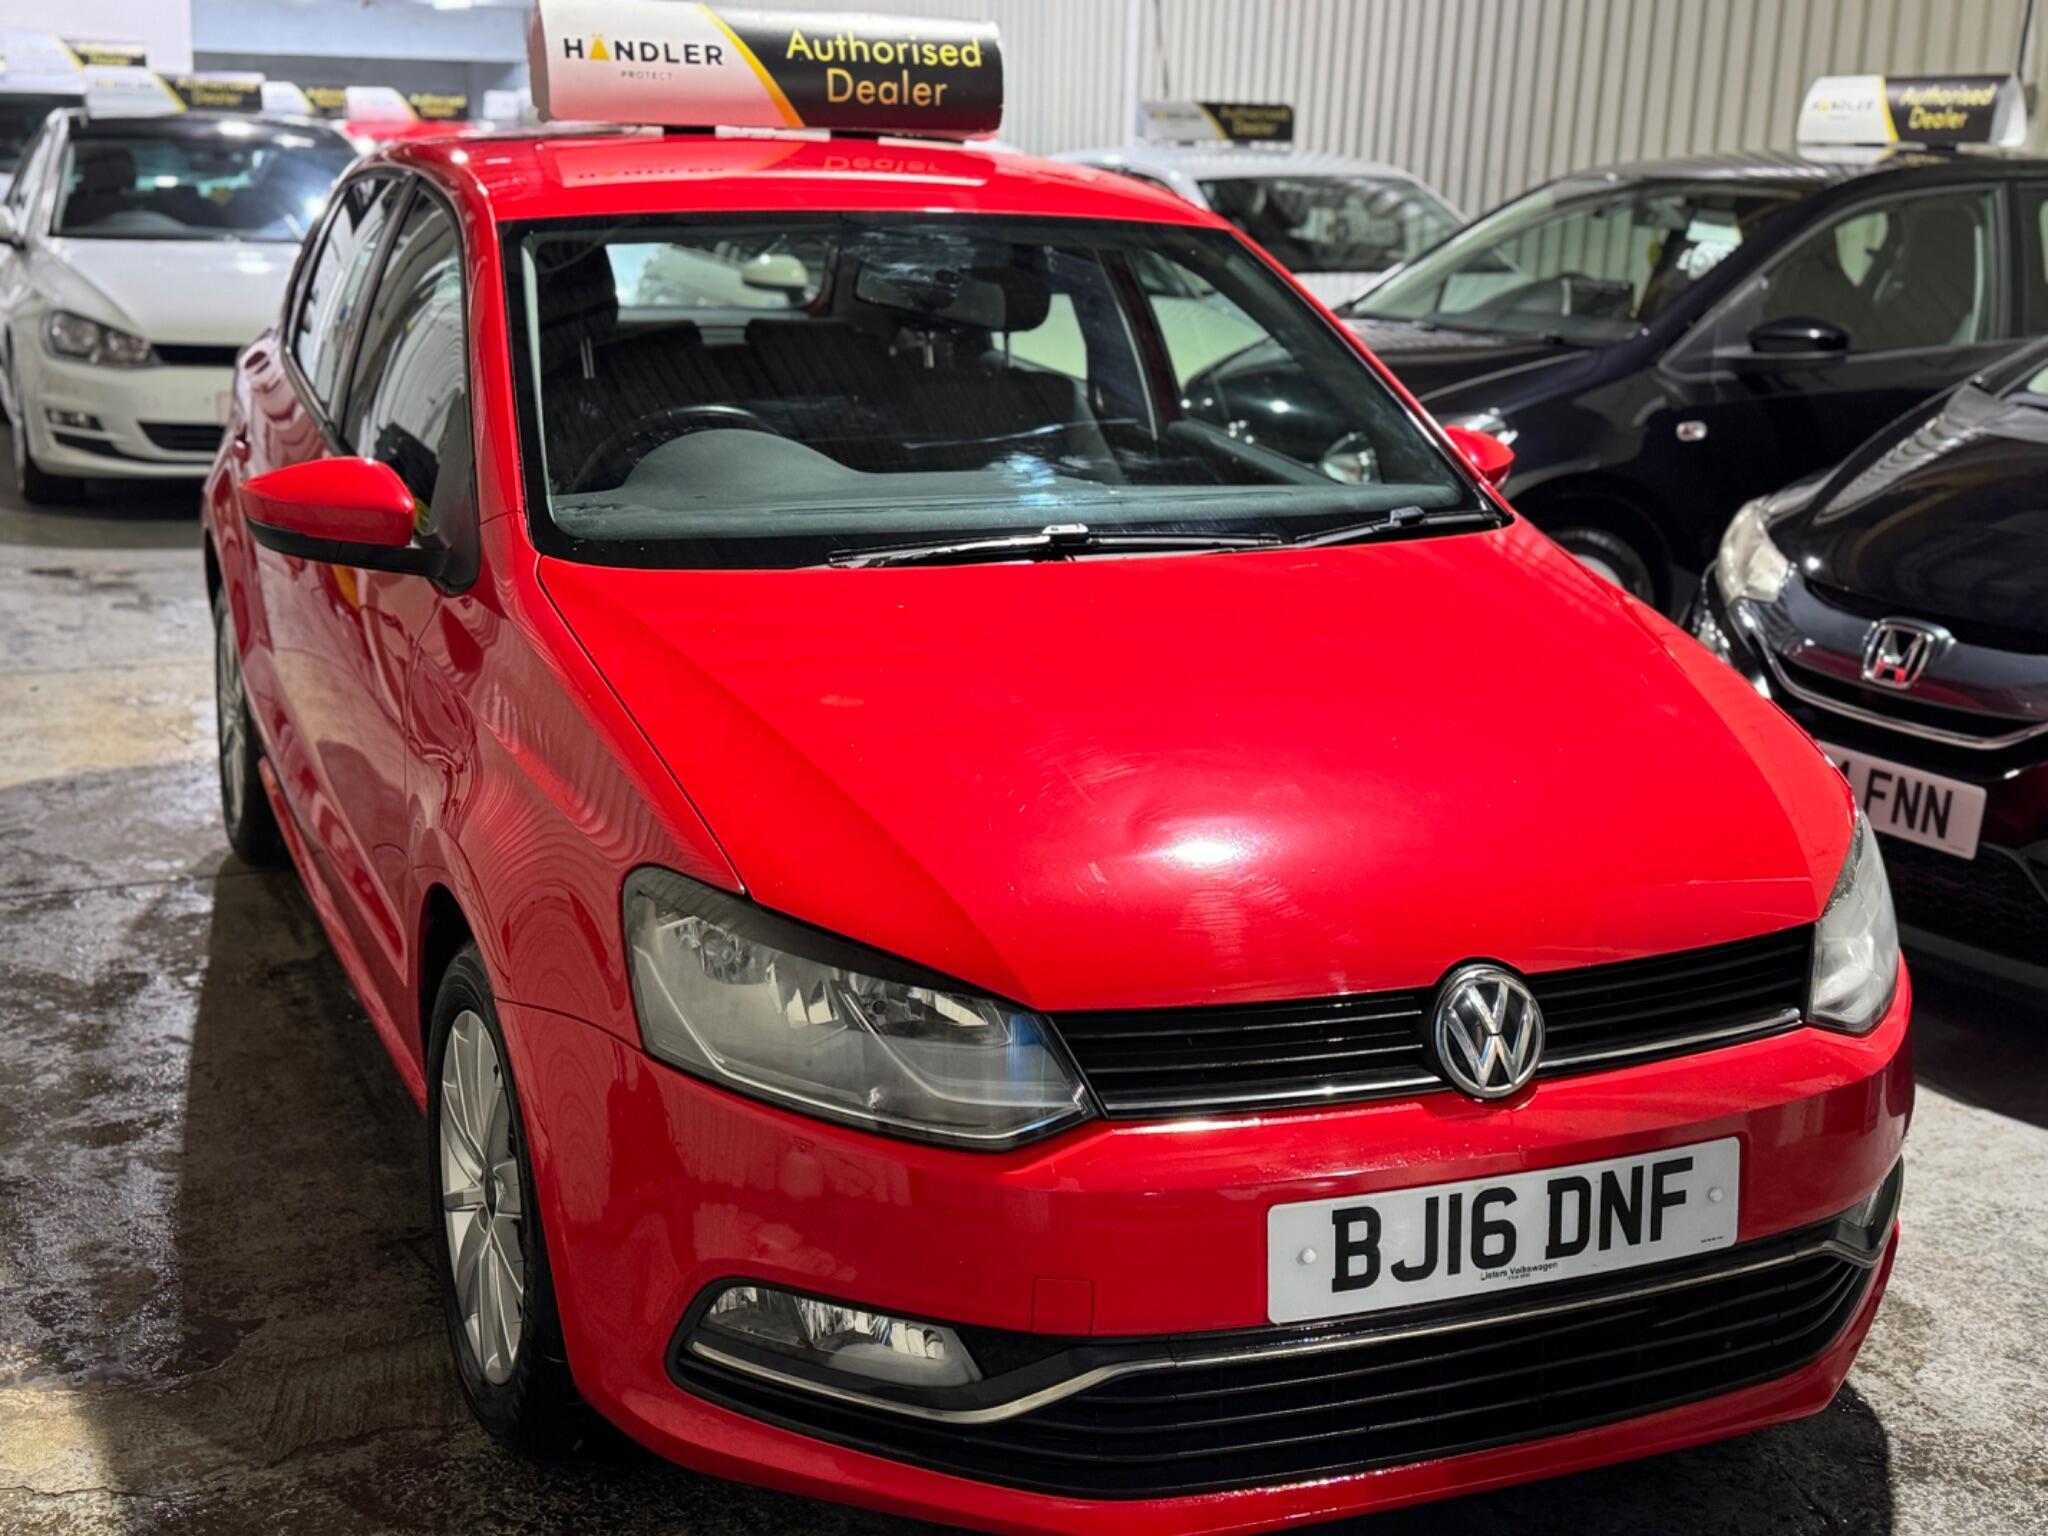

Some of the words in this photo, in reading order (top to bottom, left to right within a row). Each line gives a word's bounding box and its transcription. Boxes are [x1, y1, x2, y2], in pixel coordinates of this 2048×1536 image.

[786, 28, 982, 67] Authorised
[620, 70, 673, 81] PROTECT
[826, 67, 948, 106] Dealer
[1909, 105, 1969, 129] Dealer
[1863, 767, 1954, 840] FNN
[1331, 1186, 1518, 1293] BJ16
[1545, 1155, 1694, 1260] DNF
[1509, 1262, 1559, 1275] Volkswagen
